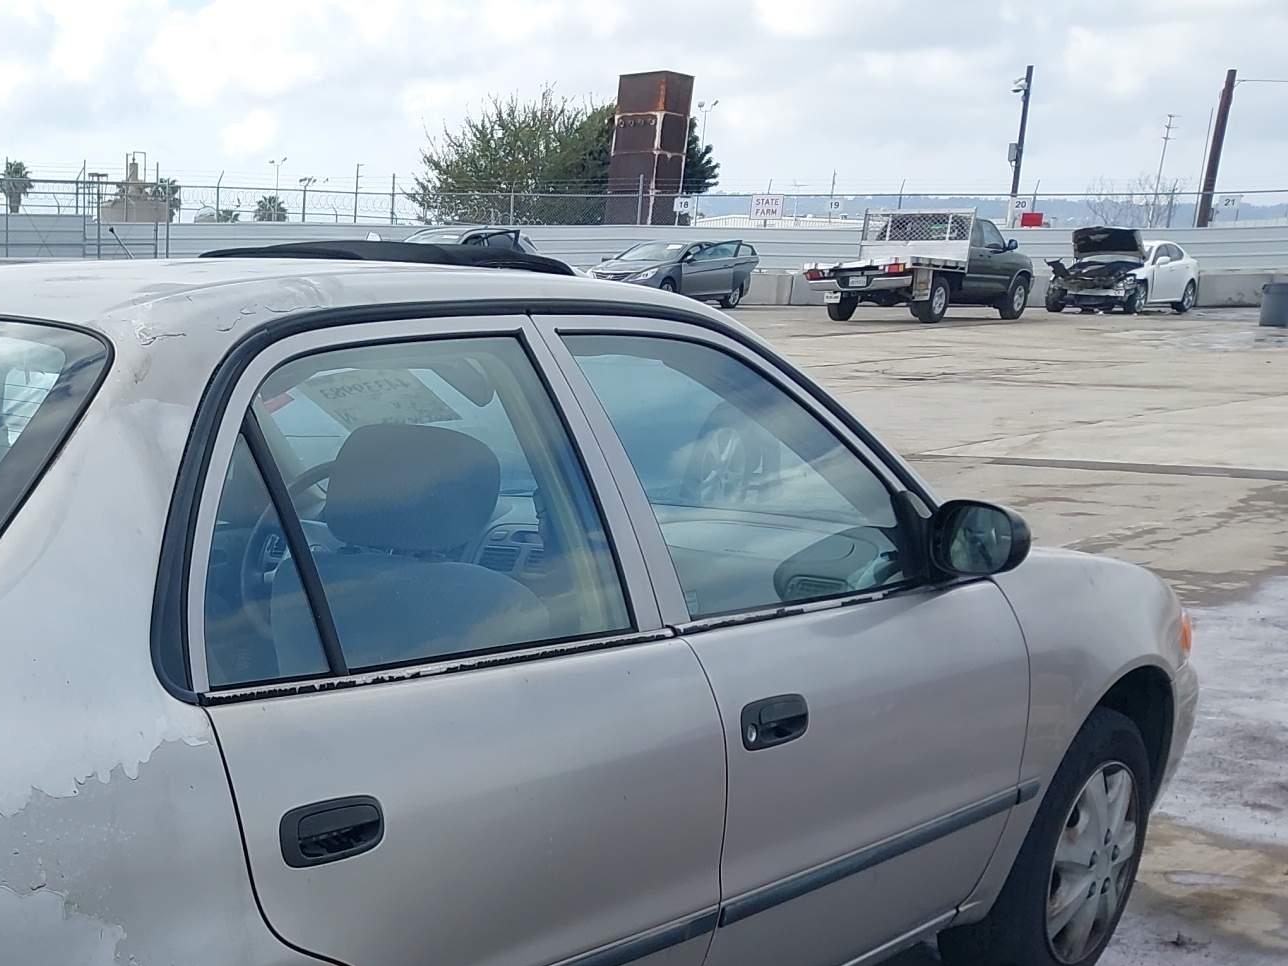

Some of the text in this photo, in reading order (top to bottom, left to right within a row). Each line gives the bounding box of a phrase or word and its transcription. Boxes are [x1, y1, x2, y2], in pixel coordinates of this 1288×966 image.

[679, 200, 689, 209] 18
[755, 198, 779, 206] STATE
[829, 200, 840, 209] 19
[1015, 200, 1027, 209] 20
[1223, 198, 1236, 207] 21
[754, 208, 777, 217] FARM
